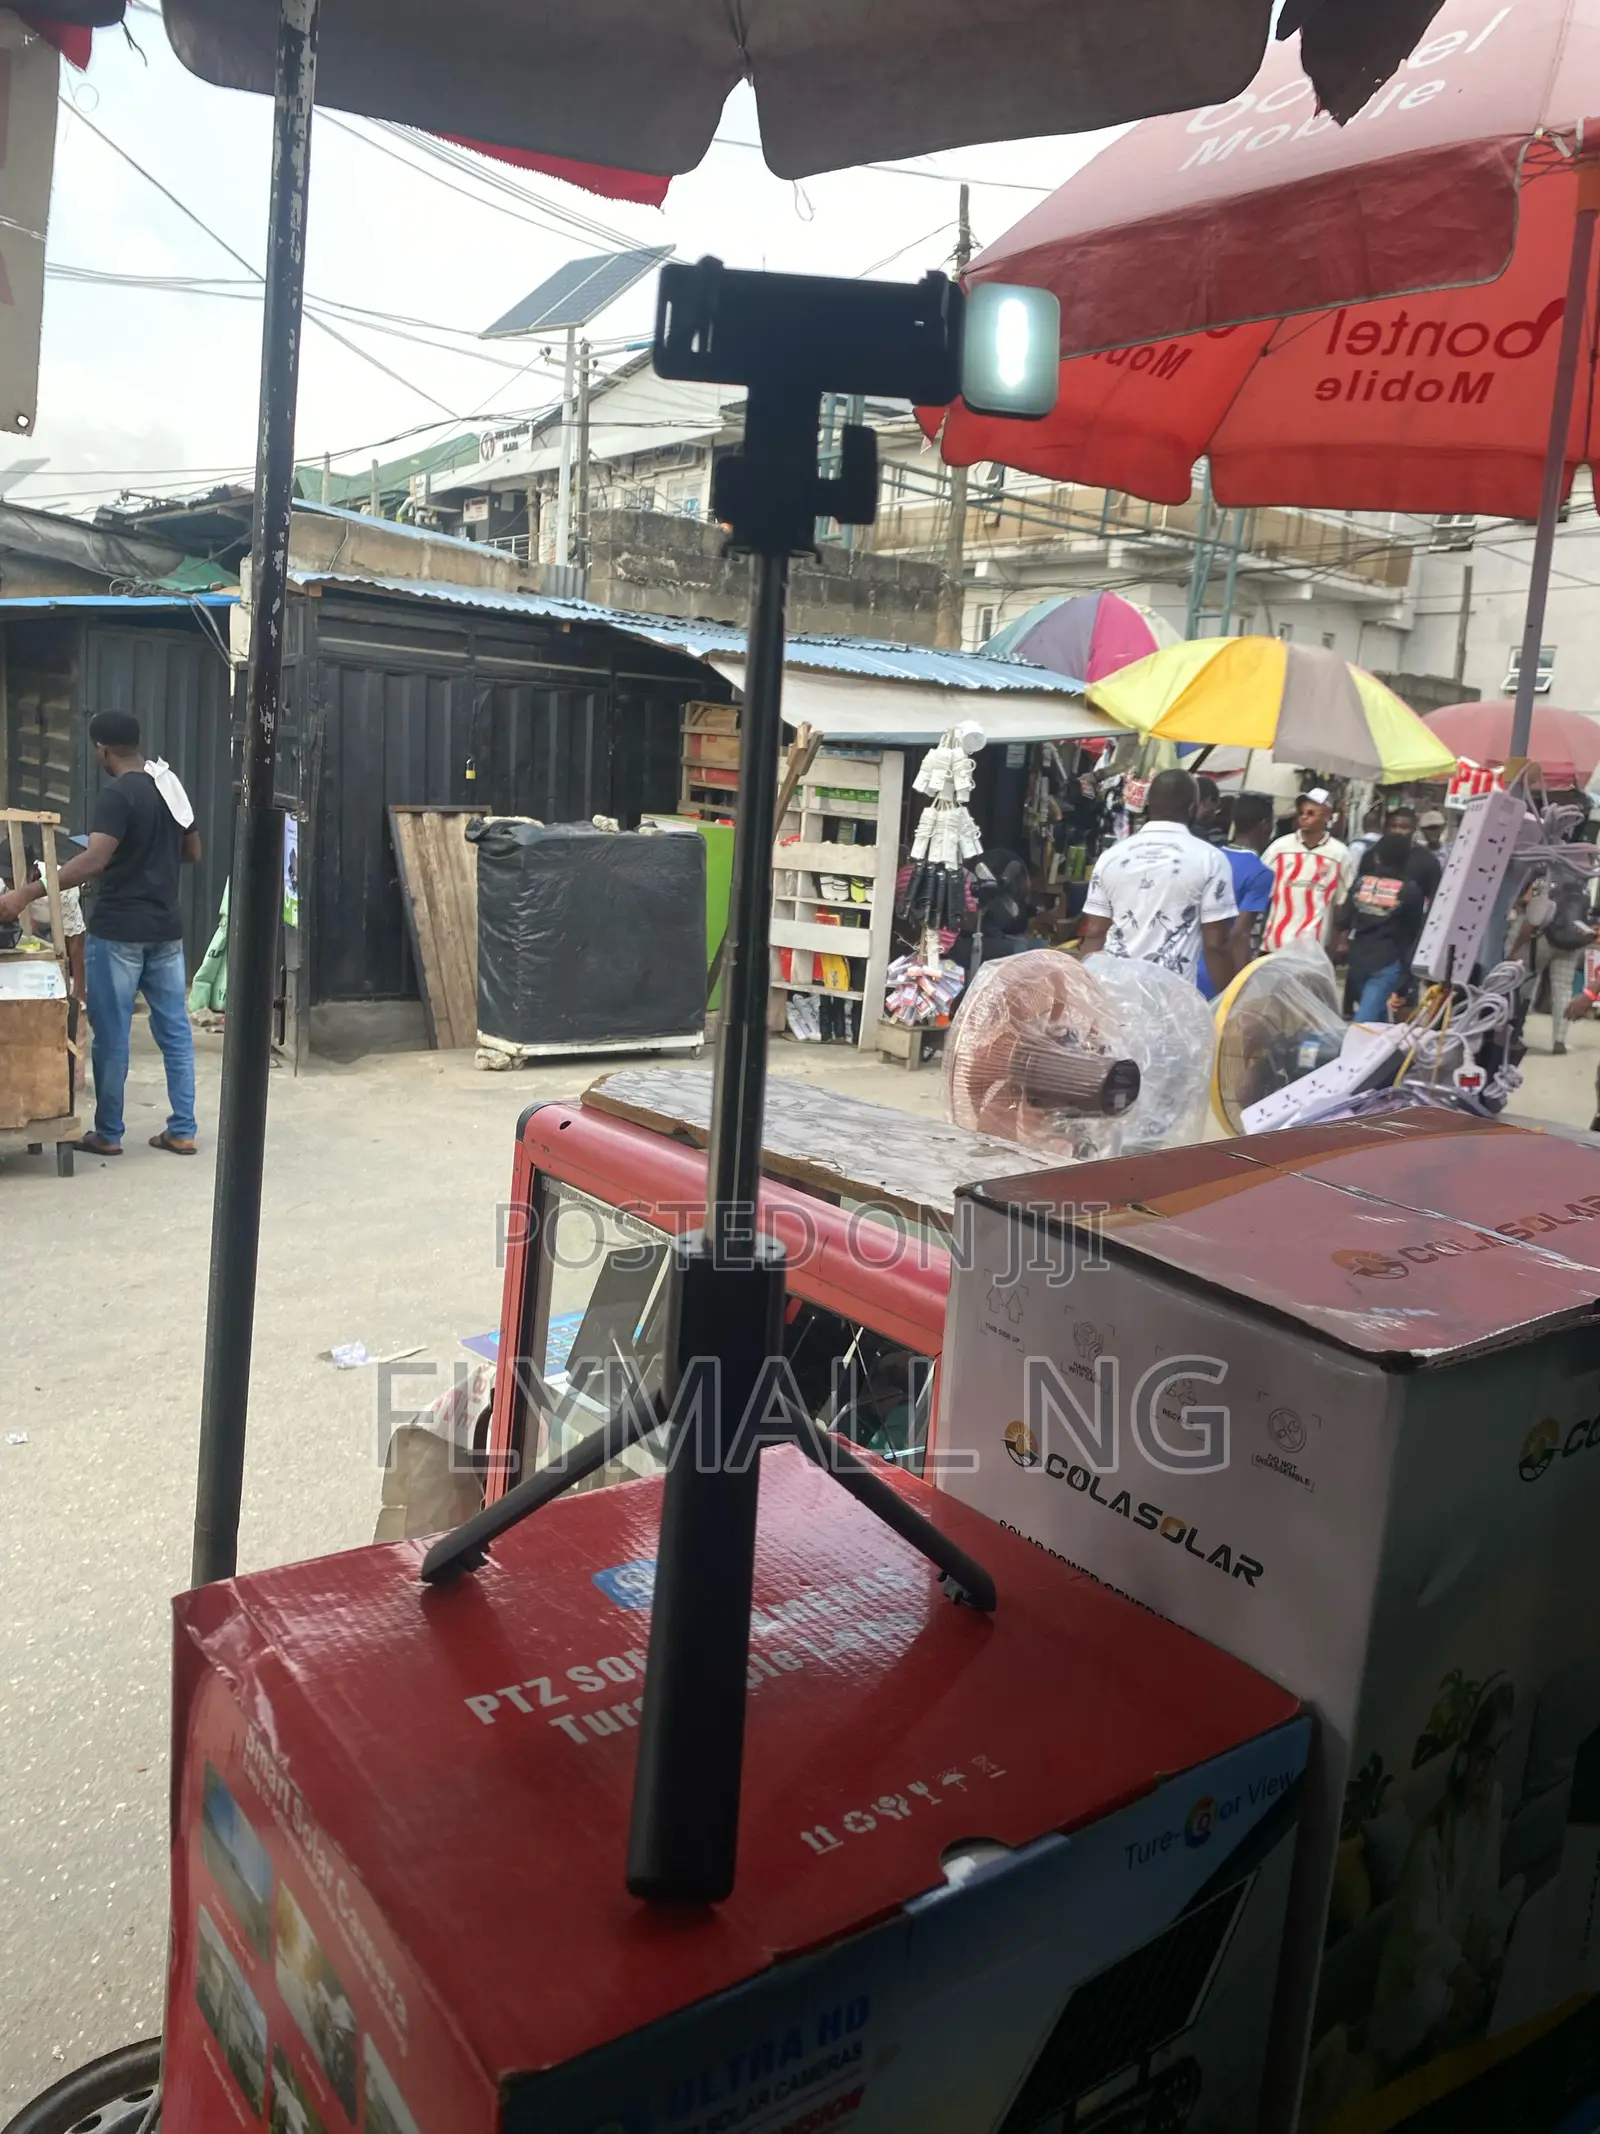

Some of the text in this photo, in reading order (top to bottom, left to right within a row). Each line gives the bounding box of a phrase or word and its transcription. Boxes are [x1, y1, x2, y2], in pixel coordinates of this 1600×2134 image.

[1178, 79, 1446, 171] Moble
[1255, 1454, 1311, 1487] DISASSEMBLE
[1281, 1458, 1298, 1473] NOT
[1045, 1453, 1265, 1588] COLASOLAR
[464, 1676, 570, 1726] PTZ
[1248, 1768, 1296, 1805] View
[246, 1723, 408, 2027] Smart Solar Camera
[667, 1994, 871, 2122] ULTRA HD
